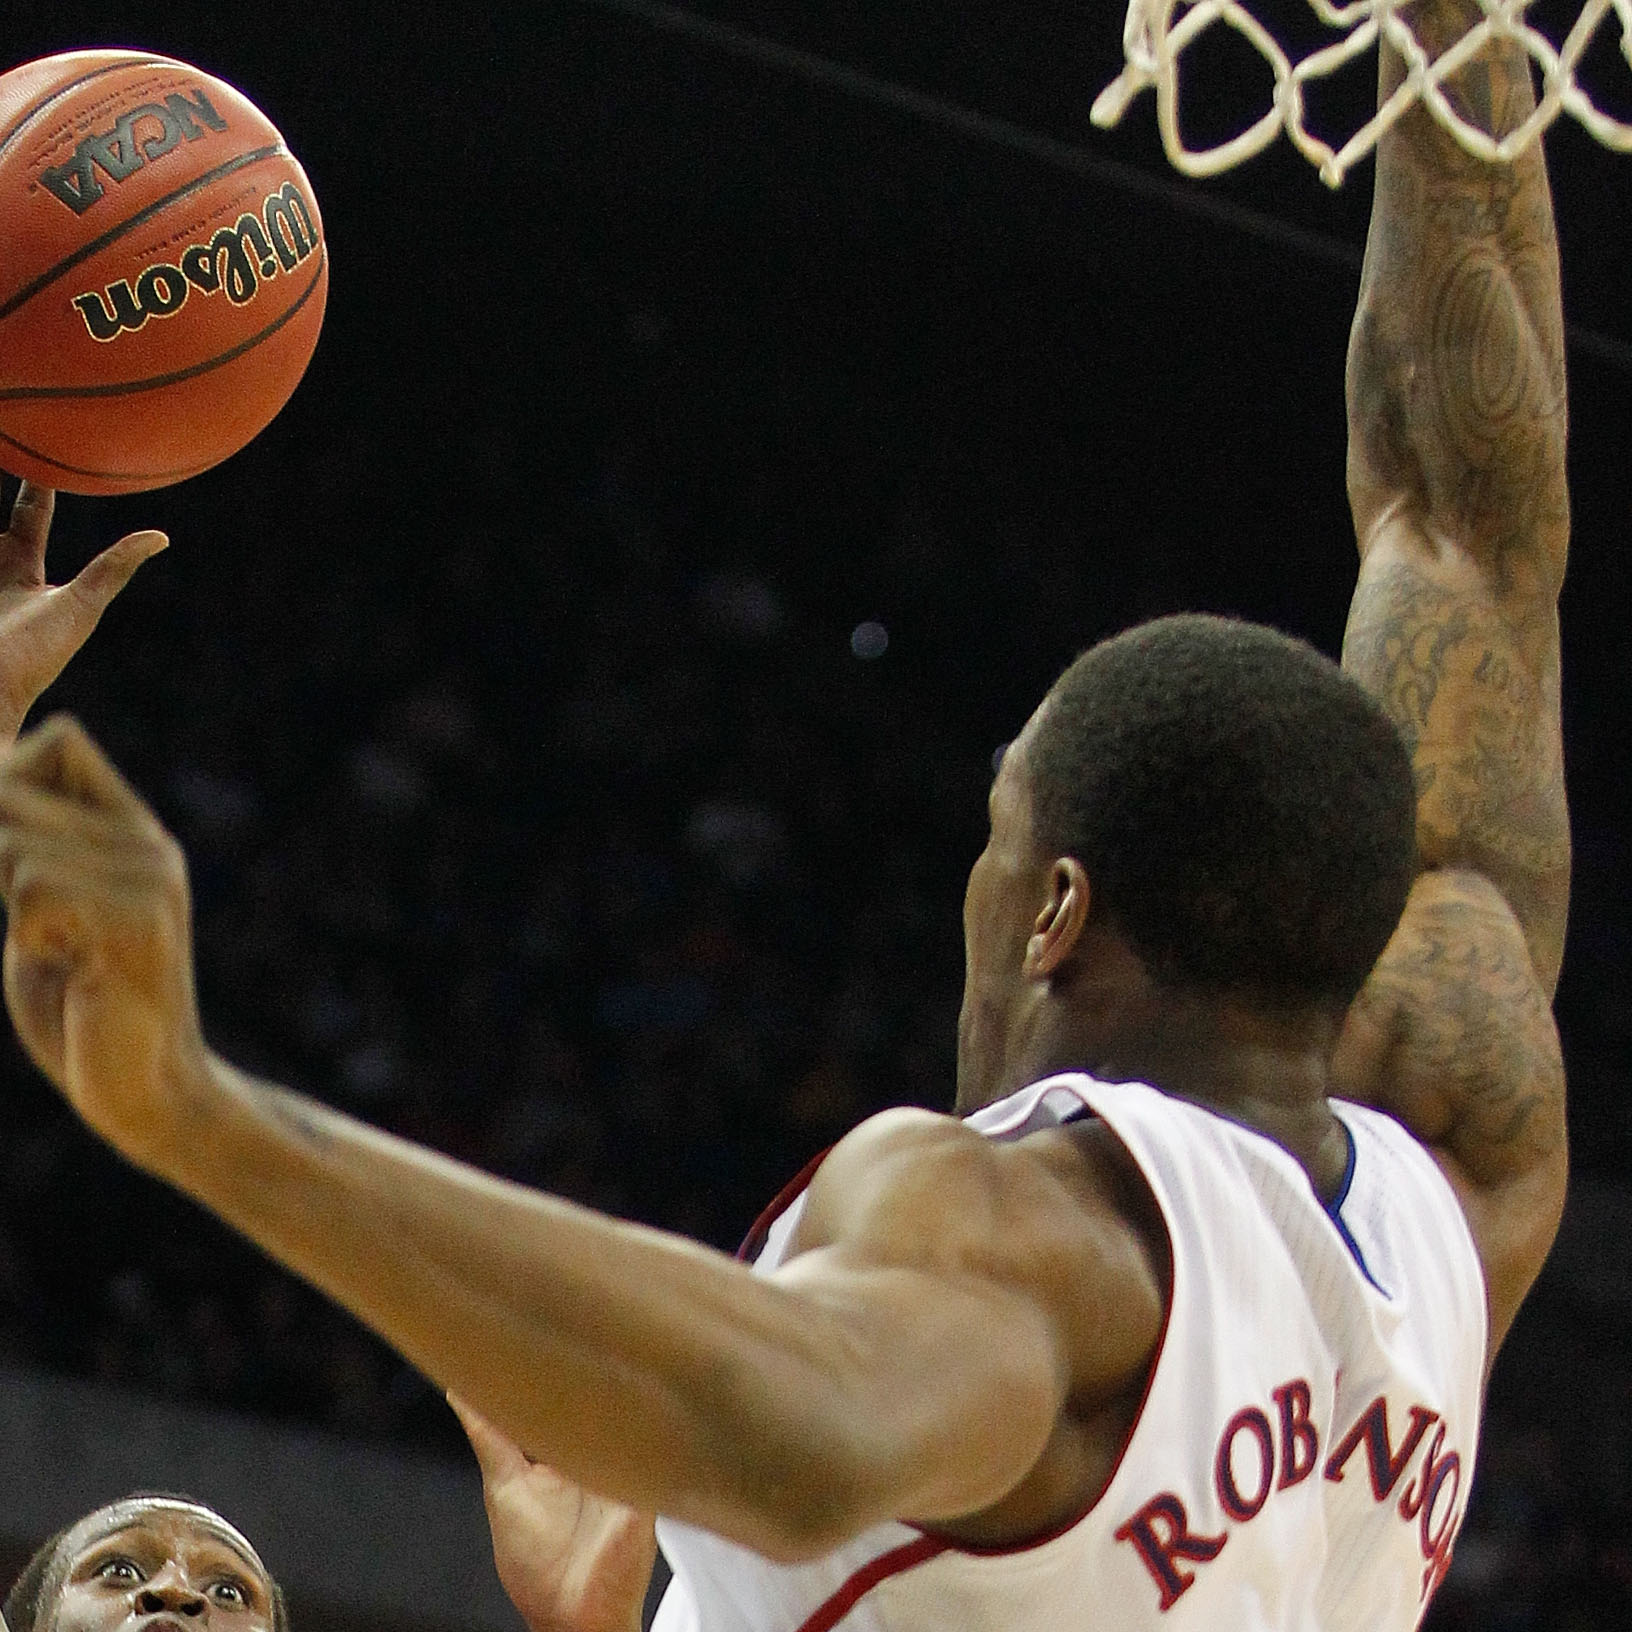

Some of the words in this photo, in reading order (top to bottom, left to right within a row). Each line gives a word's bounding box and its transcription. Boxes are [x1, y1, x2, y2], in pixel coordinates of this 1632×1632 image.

[39, 88, 228, 217] NCAA
[72, 181, 320, 342] Wilson
[1115, 1372, 1460, 1613] ROBNSO
